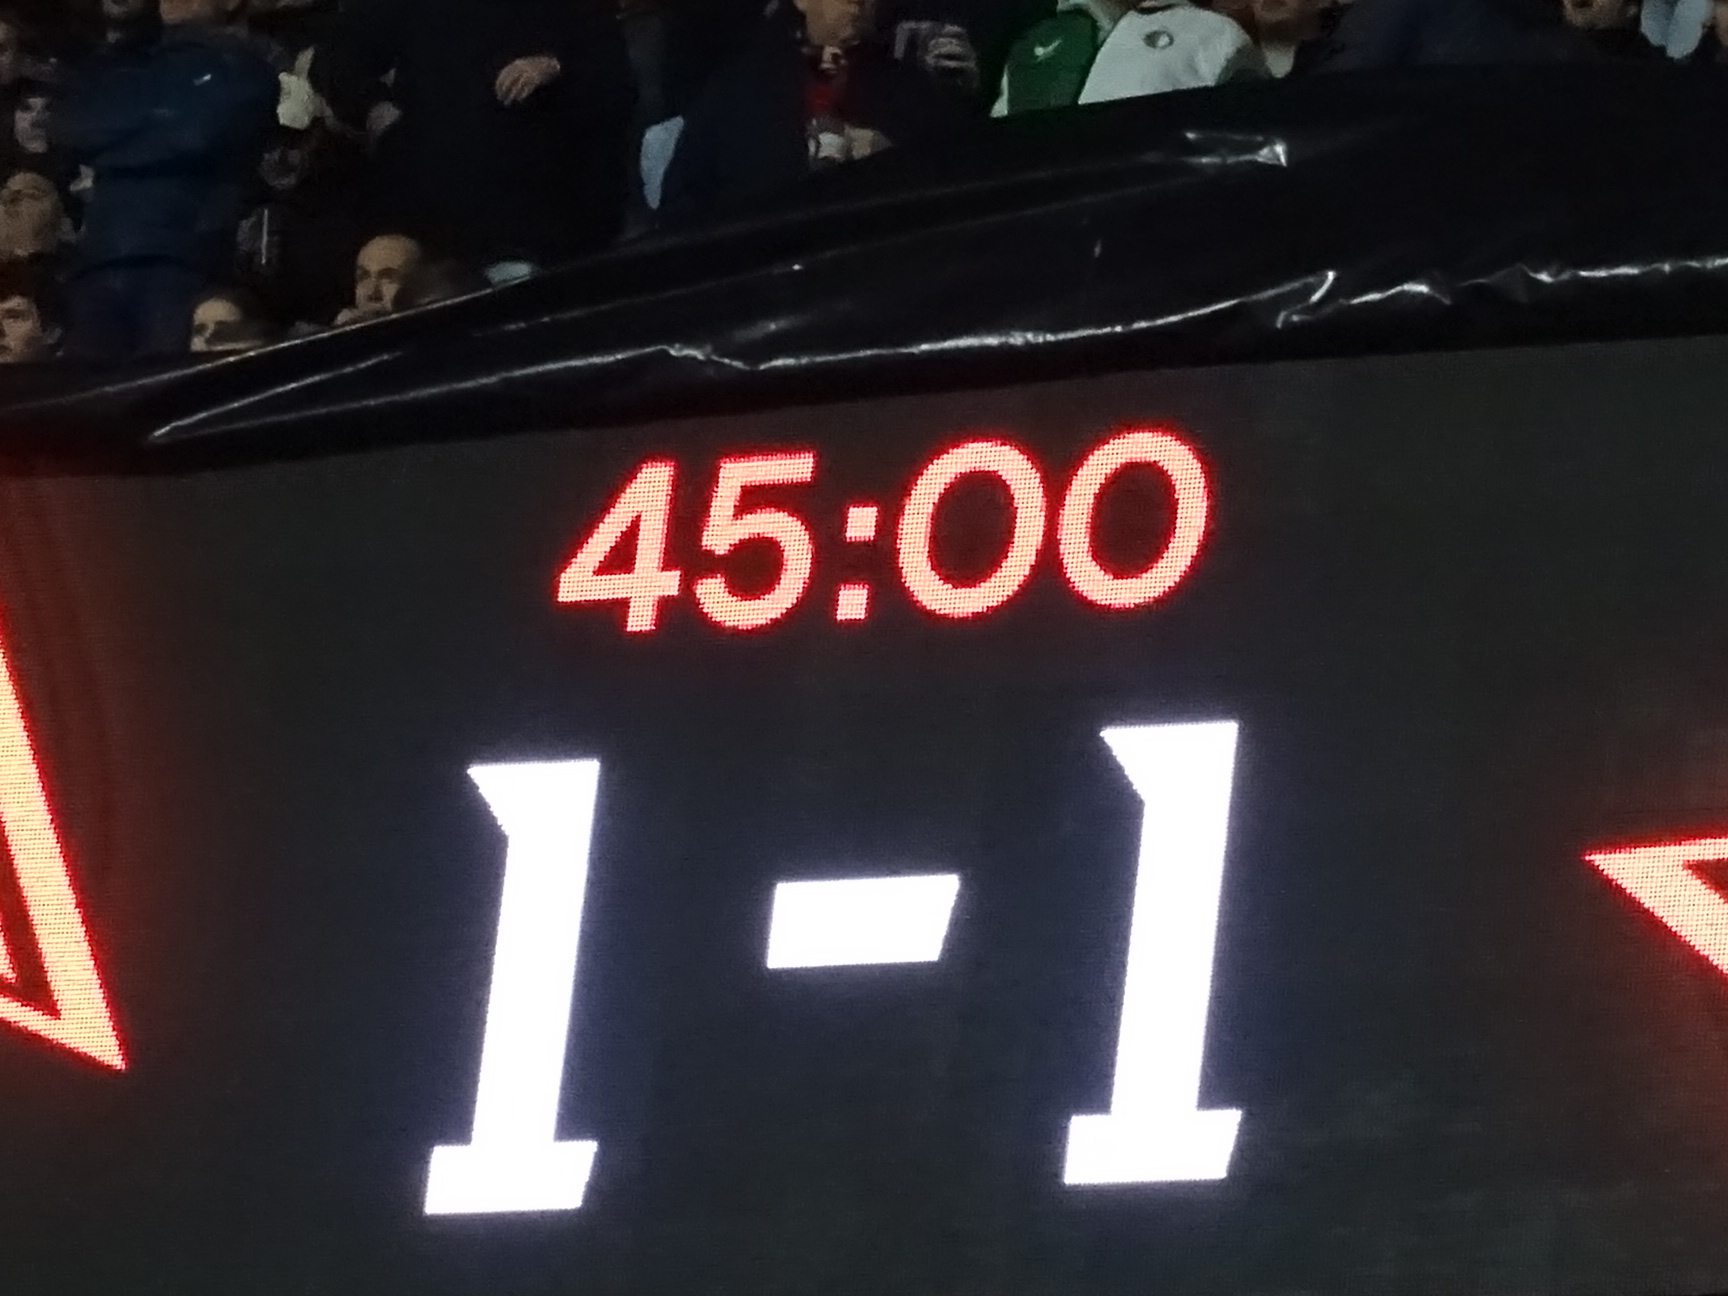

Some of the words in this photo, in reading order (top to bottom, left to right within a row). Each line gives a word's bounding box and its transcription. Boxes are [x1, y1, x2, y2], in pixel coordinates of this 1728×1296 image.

[555, 429, 1210, 633] 45:00
[423, 759, 600, 1216] 1
[766, 873, 959, 970] -
[1063, 720, 1242, 1186] 1
